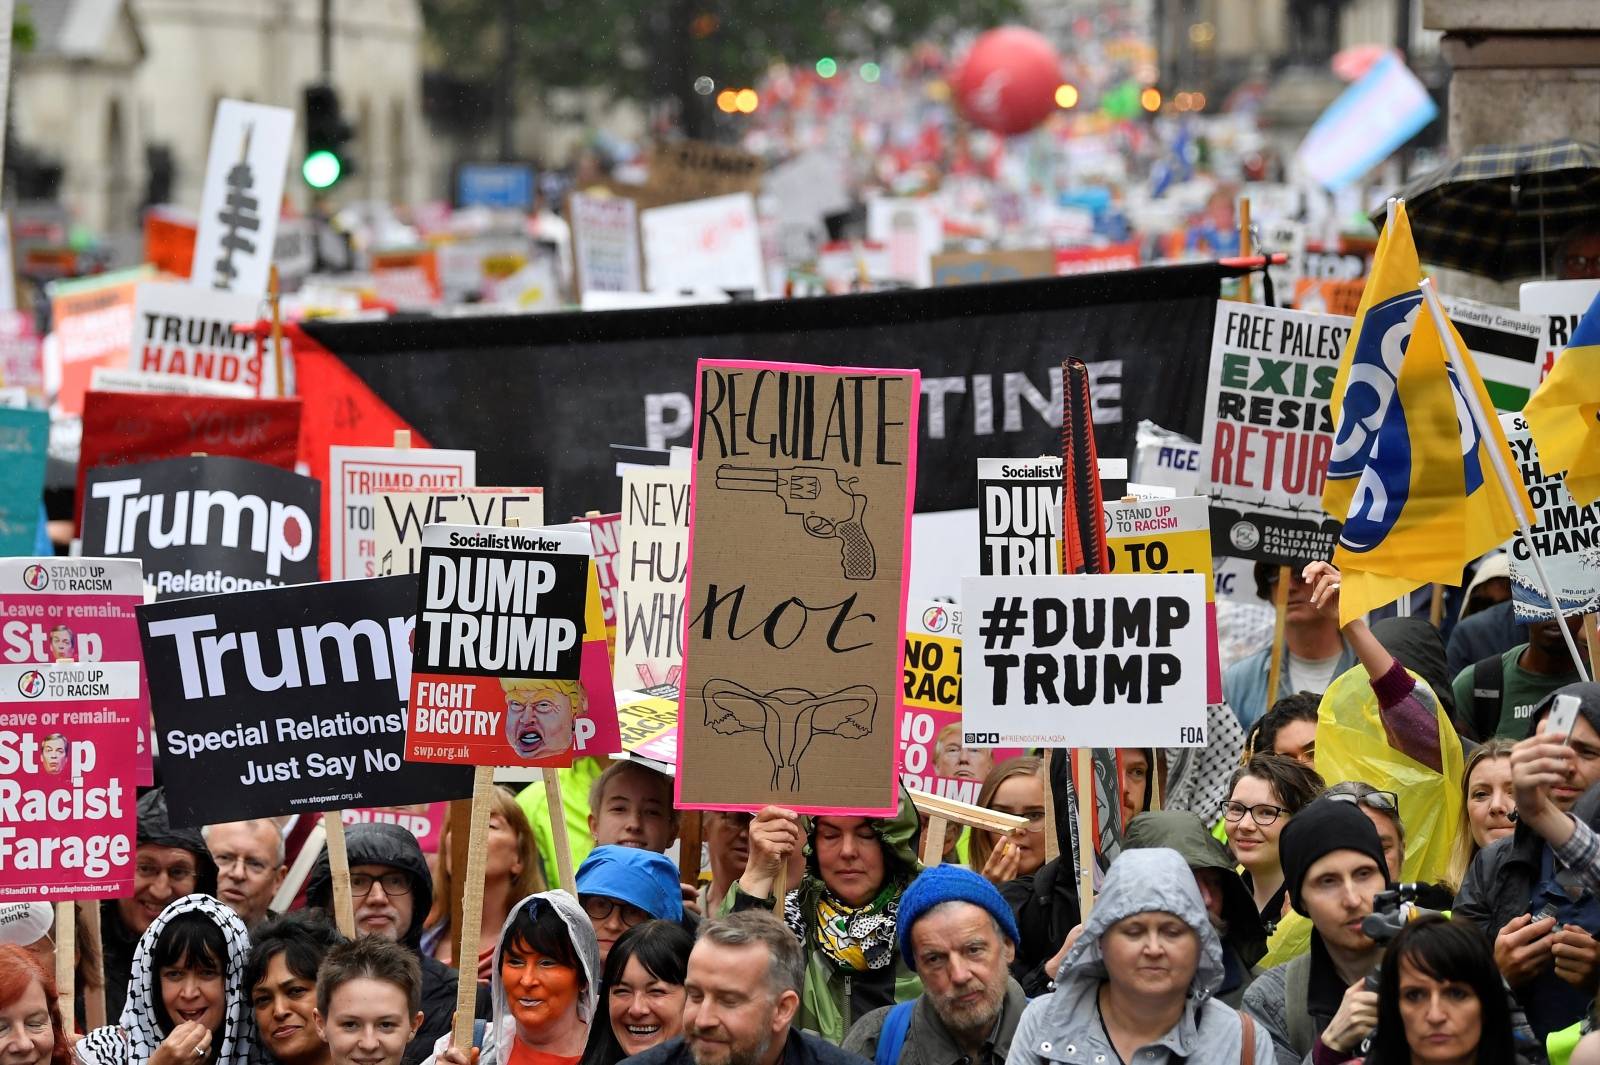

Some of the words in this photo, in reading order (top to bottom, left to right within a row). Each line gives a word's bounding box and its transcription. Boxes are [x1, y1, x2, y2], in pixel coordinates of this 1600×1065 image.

[1225, 312, 1276, 352] FREE
[1496, 316, 1541, 334] Campaign
[1220, 353, 1338, 399] EXIS
[698, 369, 905, 467] REGULATE
[1211, 422, 1333, 497] RETUR
[1002, 465, 1054, 478] Socialist
[1116, 508, 1152, 521] STAND
[1155, 506, 1171, 517] UP
[92, 478, 313, 577] Trump
[1117, 521, 1132, 533] TO
[1135, 517, 1178, 531] RACISM
[1264, 525, 1334, 543] PALESTINE
[450, 532, 509, 550] Socialist
[511, 536, 561, 552] Worker
[1263, 534, 1335, 552] SOLIDARIT
[1262, 544, 1329, 561] CAMPAIGN
[51, 567, 87, 578] STAND
[90, 567, 104, 578] UP
[53, 580, 66, 590] TO
[69, 579, 112, 591] RACISM
[426, 555, 556, 615] DUMP
[1562, 586, 1596, 595] swp.org.uk
[0, 602, 44, 617] Leave
[48, 606, 63, 617] or
[688, 584, 876, 654] not
[979, 596, 1190, 649] #DUMP
[423, 612, 577, 672] TRUMP
[49, 671, 84, 683] STAND
[88, 671, 103, 682] UP
[984, 653, 1182, 706] TRUMP
[50, 685, 64, 696] TO
[67, 684, 109, 696] RACISM
[416, 682, 477, 709] FIGHT
[42, 712, 59, 725] or
[415, 710, 502, 736] BIGOTRY
[167, 720, 268, 759] Special
[1180, 727, 1204, 744] FOA
[414, 746, 470, 760] swp.org.uk
[240, 757, 301, 786] Just
[307, 753, 356, 780] Say
[364, 748, 401, 773] No
[0, 778, 123, 822] Racist
[290, 792, 363, 805] www.stopwar.org.uk
[0, 911, 30, 925] stinks
